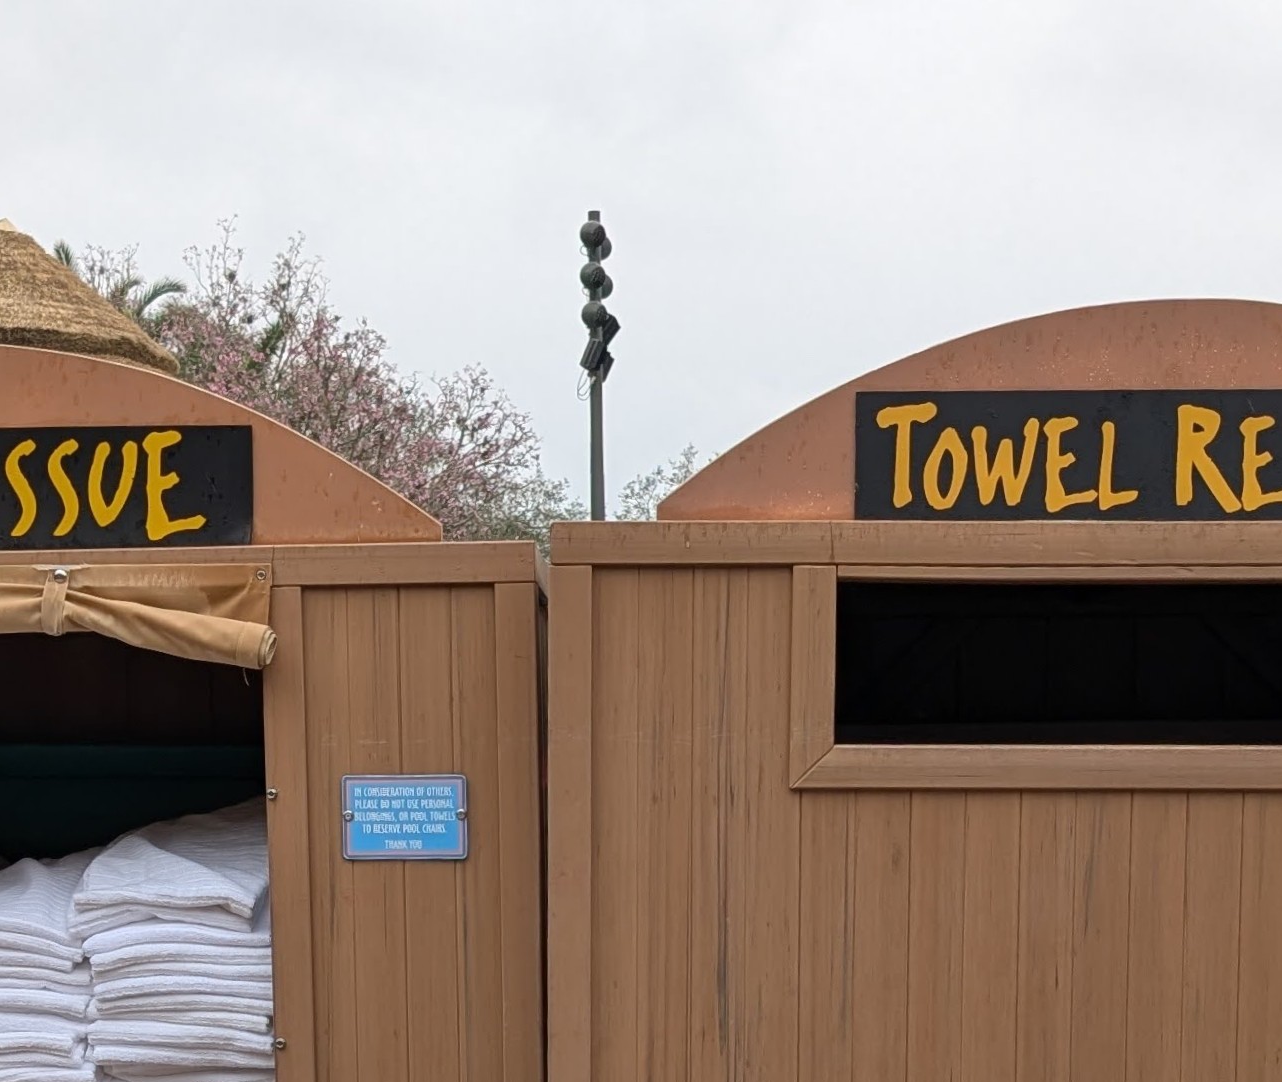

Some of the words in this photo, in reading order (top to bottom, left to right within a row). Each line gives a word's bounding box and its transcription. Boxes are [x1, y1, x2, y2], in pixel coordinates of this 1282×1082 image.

[876, 401, 1139, 513] TOWEL
[354, 787, 362, 797] IN
[363, 787, 415, 797] CONSIDERATION
[416, 787, 425, 797] OF
[354, 799, 378, 809] PLEASE
[380, 799, 390, 809] DO
[391, 799, 405, 809] NOT
[407, 799, 419, 809] USE
[421, 799, 454, 809] PERSONAL
[398, 811, 409, 822] OR
[410, 811, 427, 822] POOL
[430, 811, 456, 822] TOWELS
[362, 823, 372, 834] TO
[373, 823, 401, 834] RESERVE
[403, 823, 421, 834] POOL
[385, 840, 408, 850] THANK
[409, 840, 422, 850] YOU
